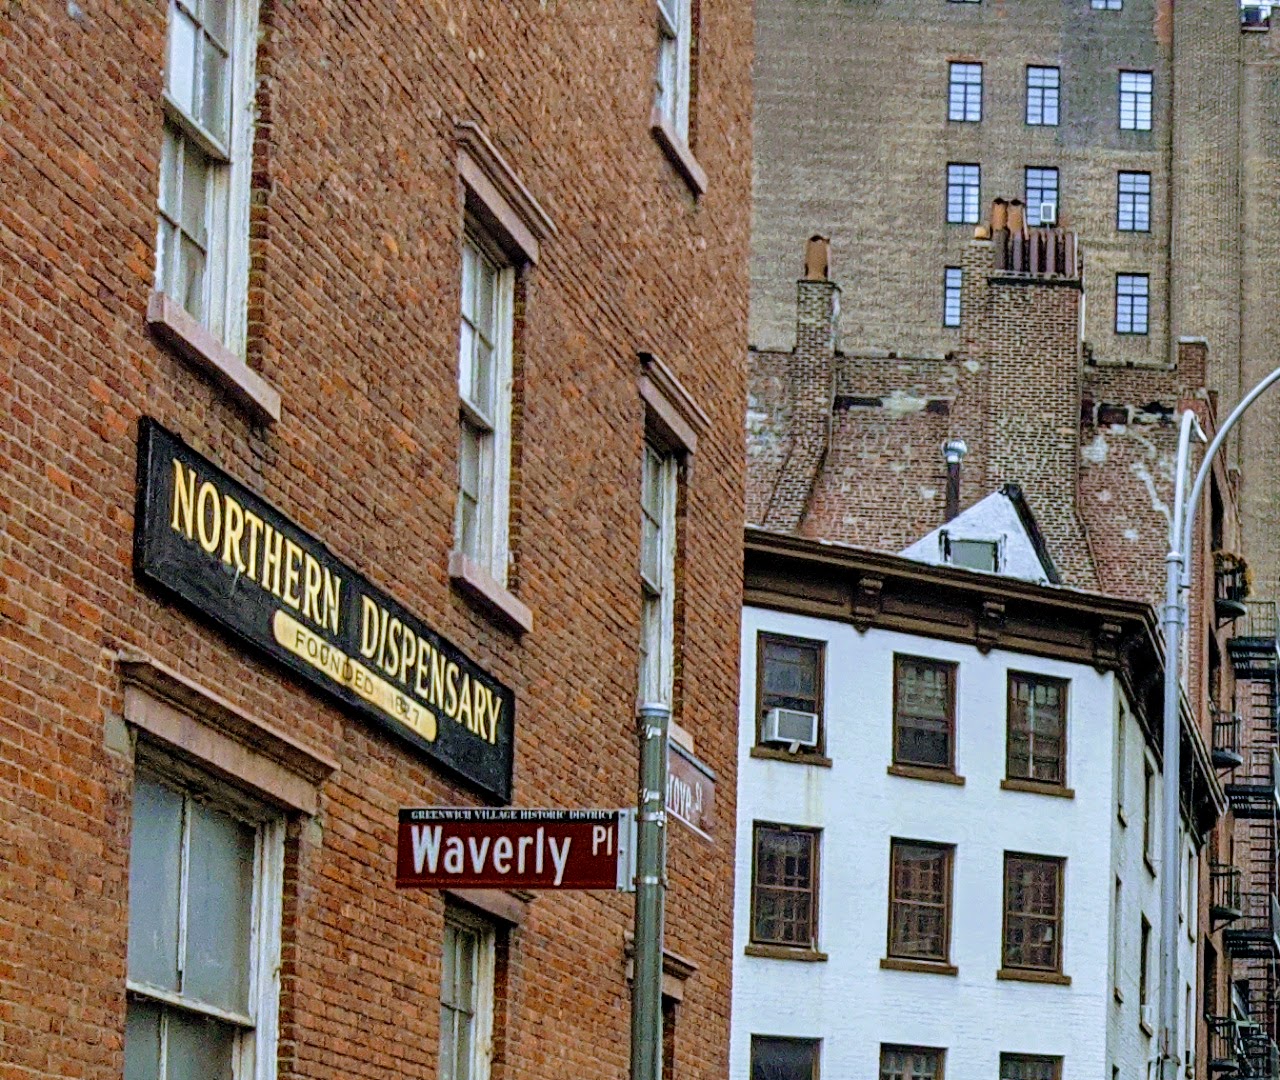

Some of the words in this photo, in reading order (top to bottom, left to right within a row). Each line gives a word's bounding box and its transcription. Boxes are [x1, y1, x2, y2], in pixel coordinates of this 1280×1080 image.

[170, 457, 341, 636] NORTHERN
[359, 594, 502, 745] DISPENSARY
[294, 629, 374, 696] FOUNDED
[411, 810, 471, 820] GREENWICH
[474, 810, 517, 820] VILLAGE
[520, 810, 565, 820] HISTORIC
[569, 810, 614, 820] DISTRICT
[410, 825, 572, 887] Waverly
[592, 825, 613, 856] Pl
